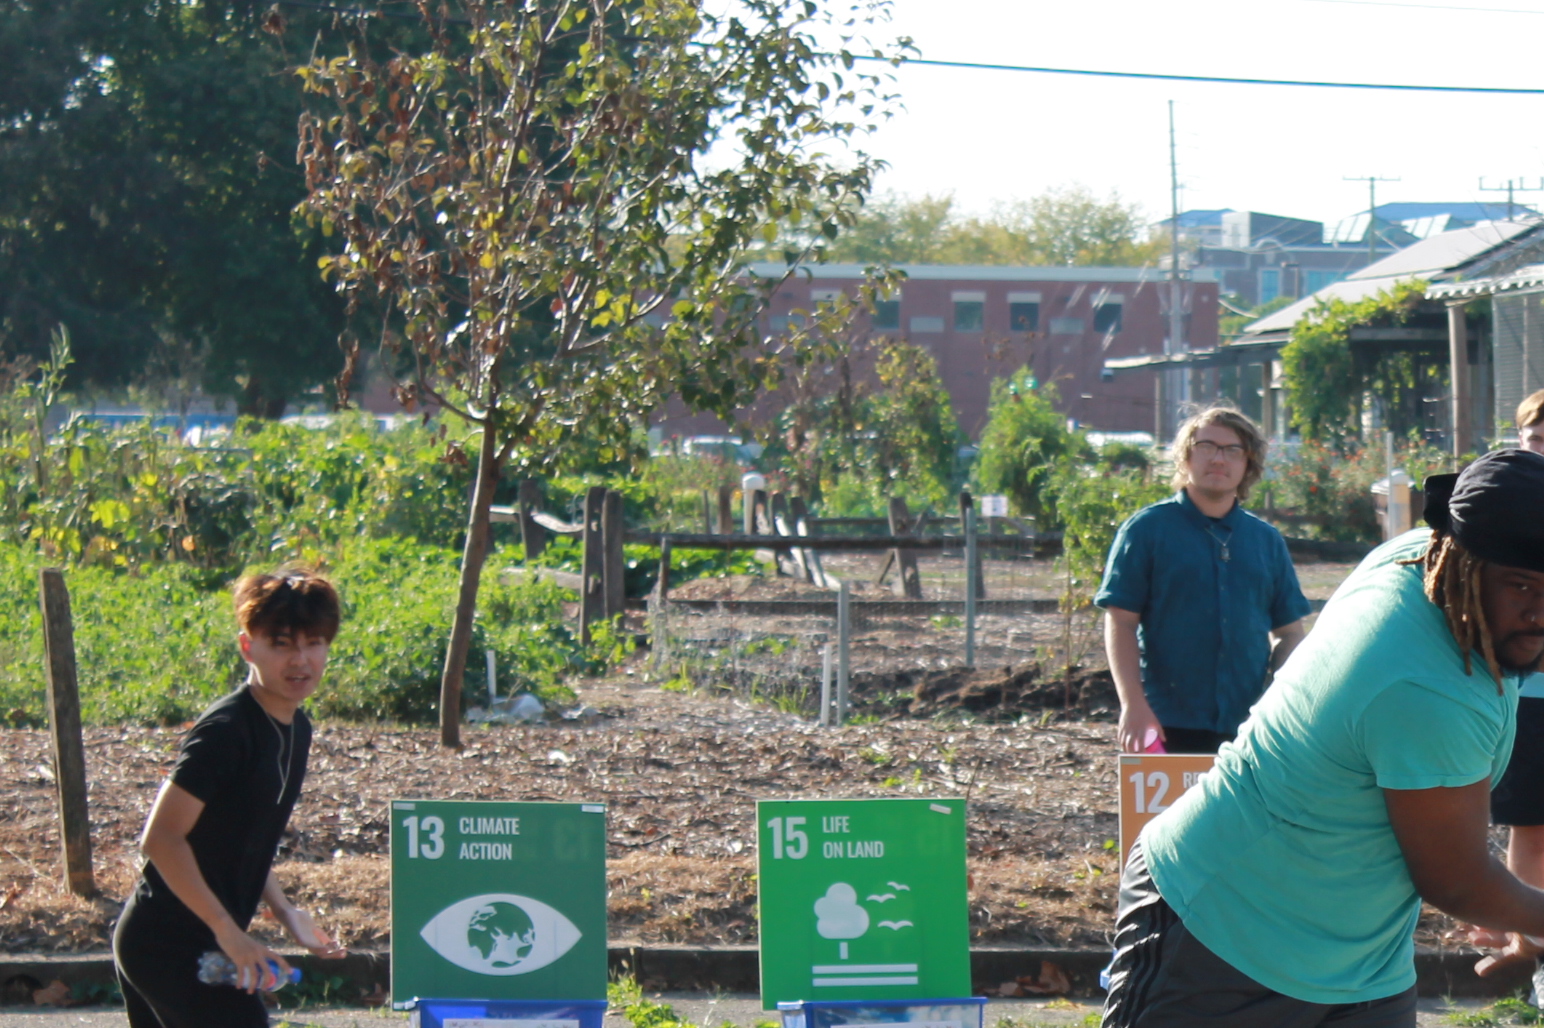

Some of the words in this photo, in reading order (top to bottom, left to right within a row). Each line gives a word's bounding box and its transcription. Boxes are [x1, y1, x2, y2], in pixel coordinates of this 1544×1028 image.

[1129, 771, 1171, 814] 12
[402, 815, 446, 860] 13
[459, 816, 521, 836] CLIMATE
[459, 842, 513, 861] ACTION
[766, 816, 809, 860] 15
[822, 815, 851, 834] LIFE
[822, 841, 844, 859] ON
[847, 840, 885, 859] LAND
